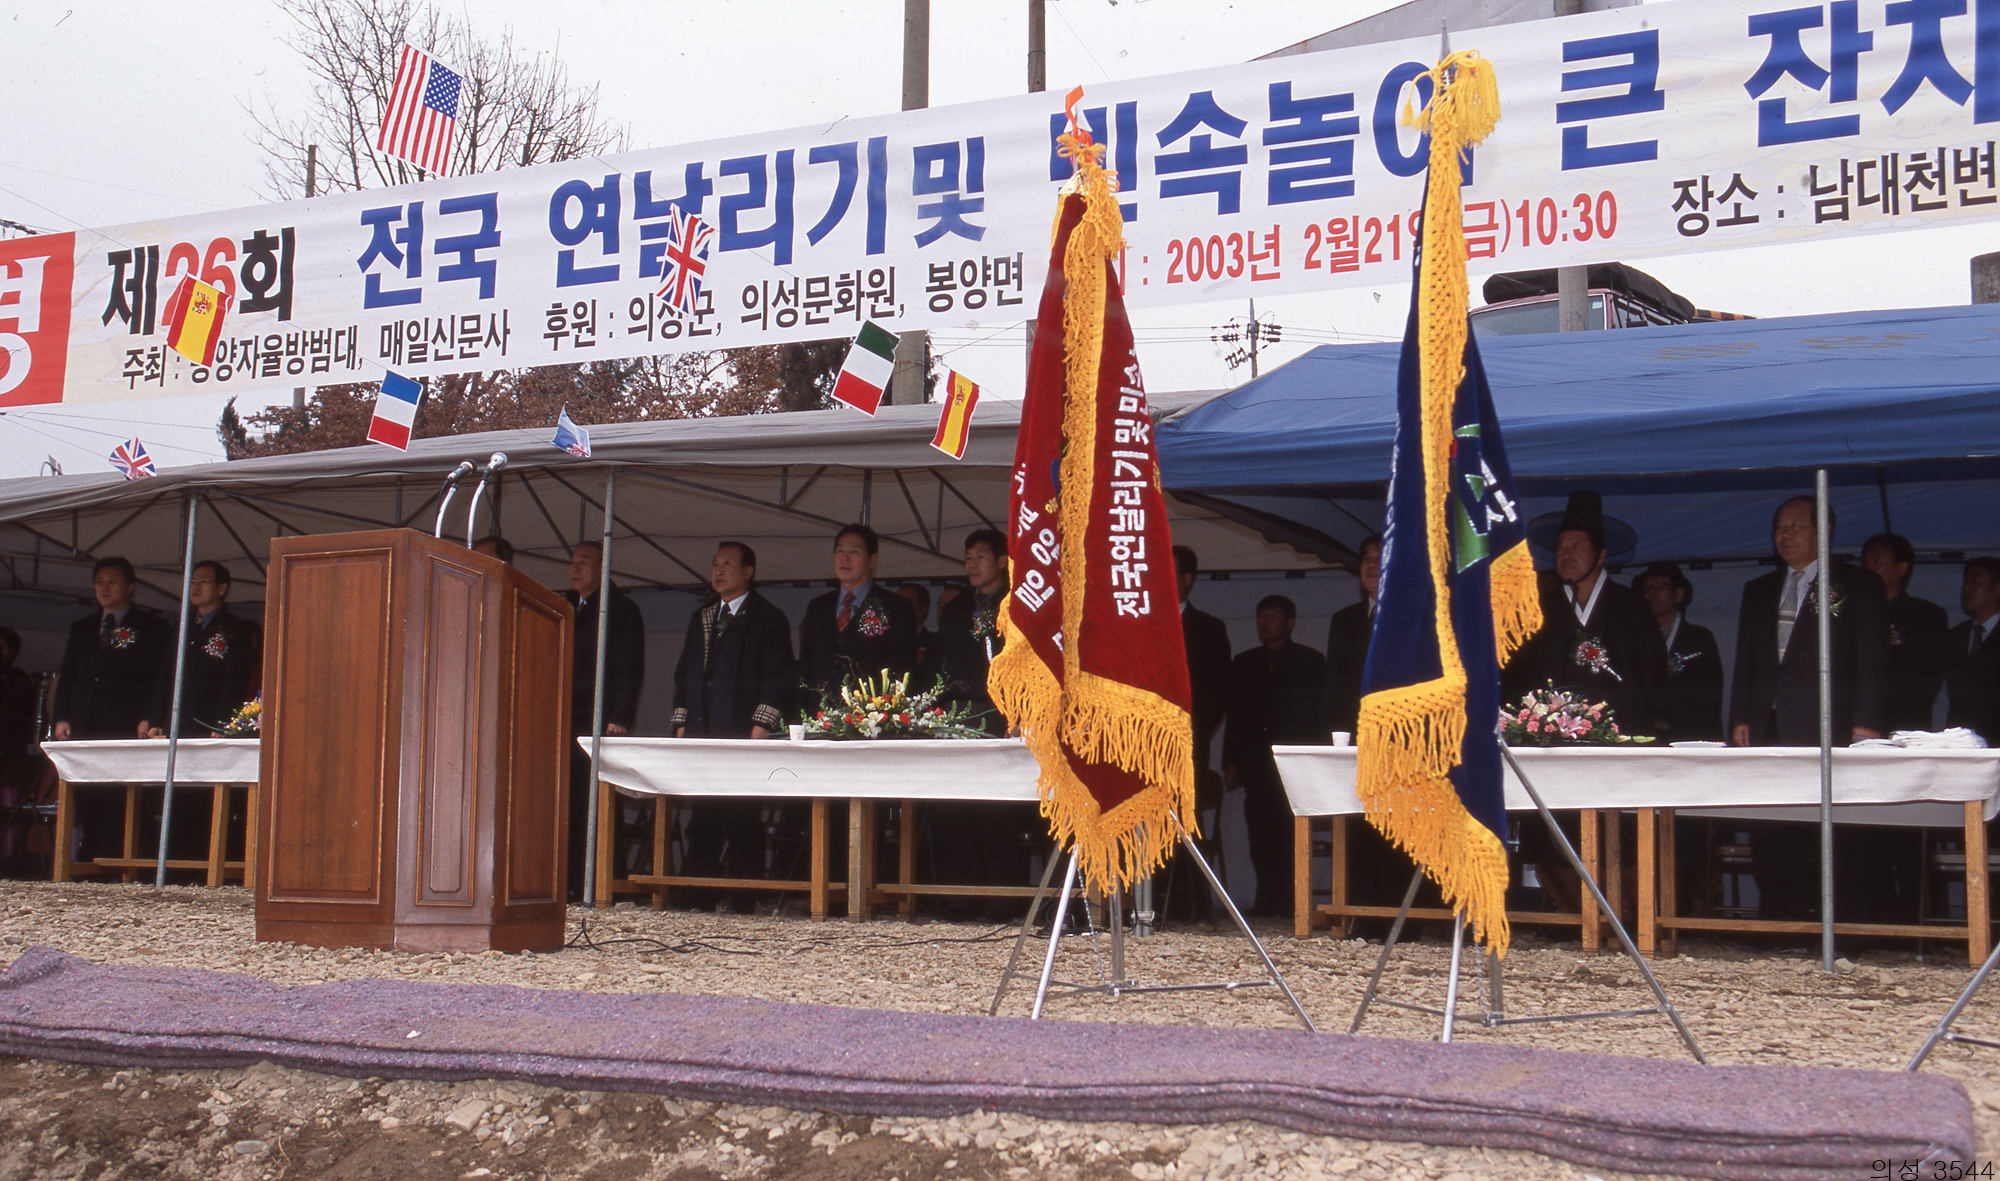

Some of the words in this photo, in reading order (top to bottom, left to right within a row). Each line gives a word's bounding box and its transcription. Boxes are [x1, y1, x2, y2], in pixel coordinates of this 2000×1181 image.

[1671, 172, 1760, 238] 장소
[1808, 140, 1998, 225] 남대천변
[101, 226, 296, 335] 제26회
[357, 191, 502, 310] 전국
[543, 298, 598, 351] 후원
[740, 265, 905, 331] 의성문화원,
[925, 251, 1024, 314] 봉양면
[1166, 223, 1281, 284] 2003년
[379, 309, 511, 367] 매일신문사
